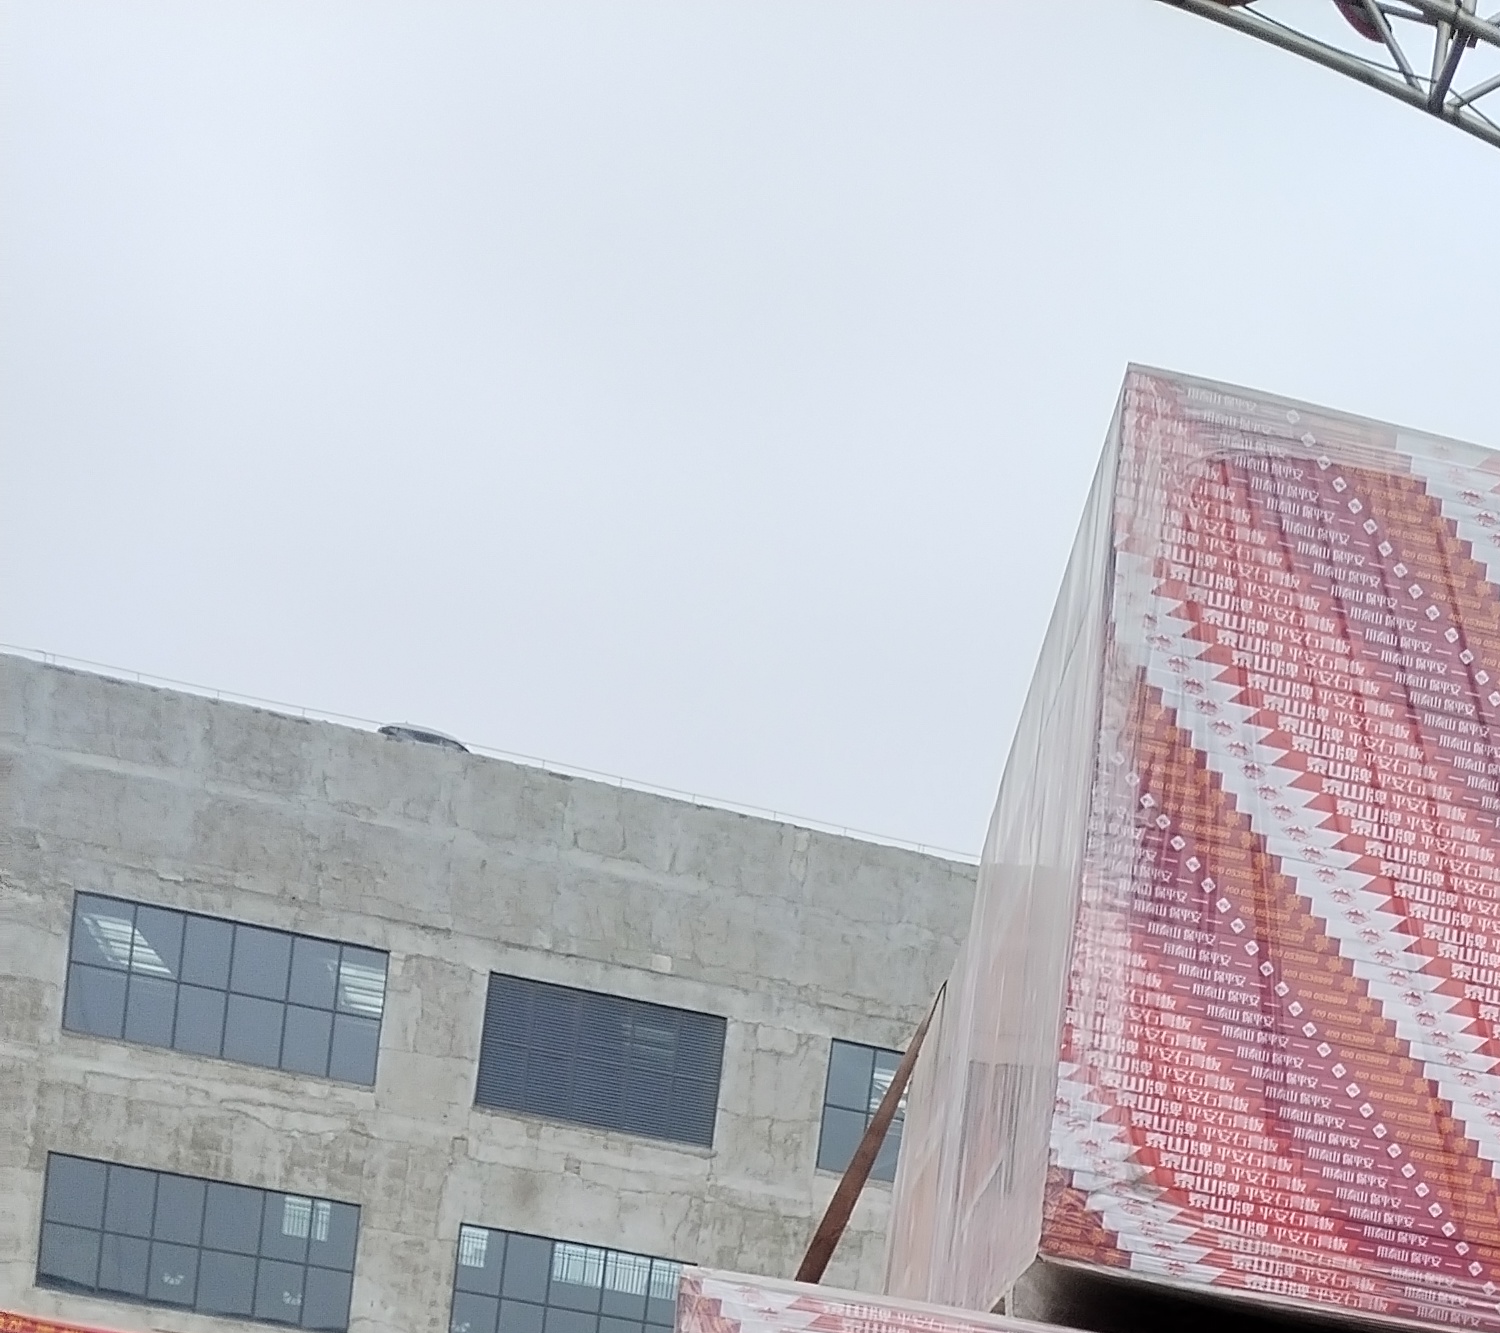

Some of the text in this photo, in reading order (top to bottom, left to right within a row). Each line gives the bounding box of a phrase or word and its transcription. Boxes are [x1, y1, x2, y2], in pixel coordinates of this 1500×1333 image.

[1146, 1132, 1211, 1158] 泰山牌
[1174, 1172, 1239, 1198] 泰山牌
